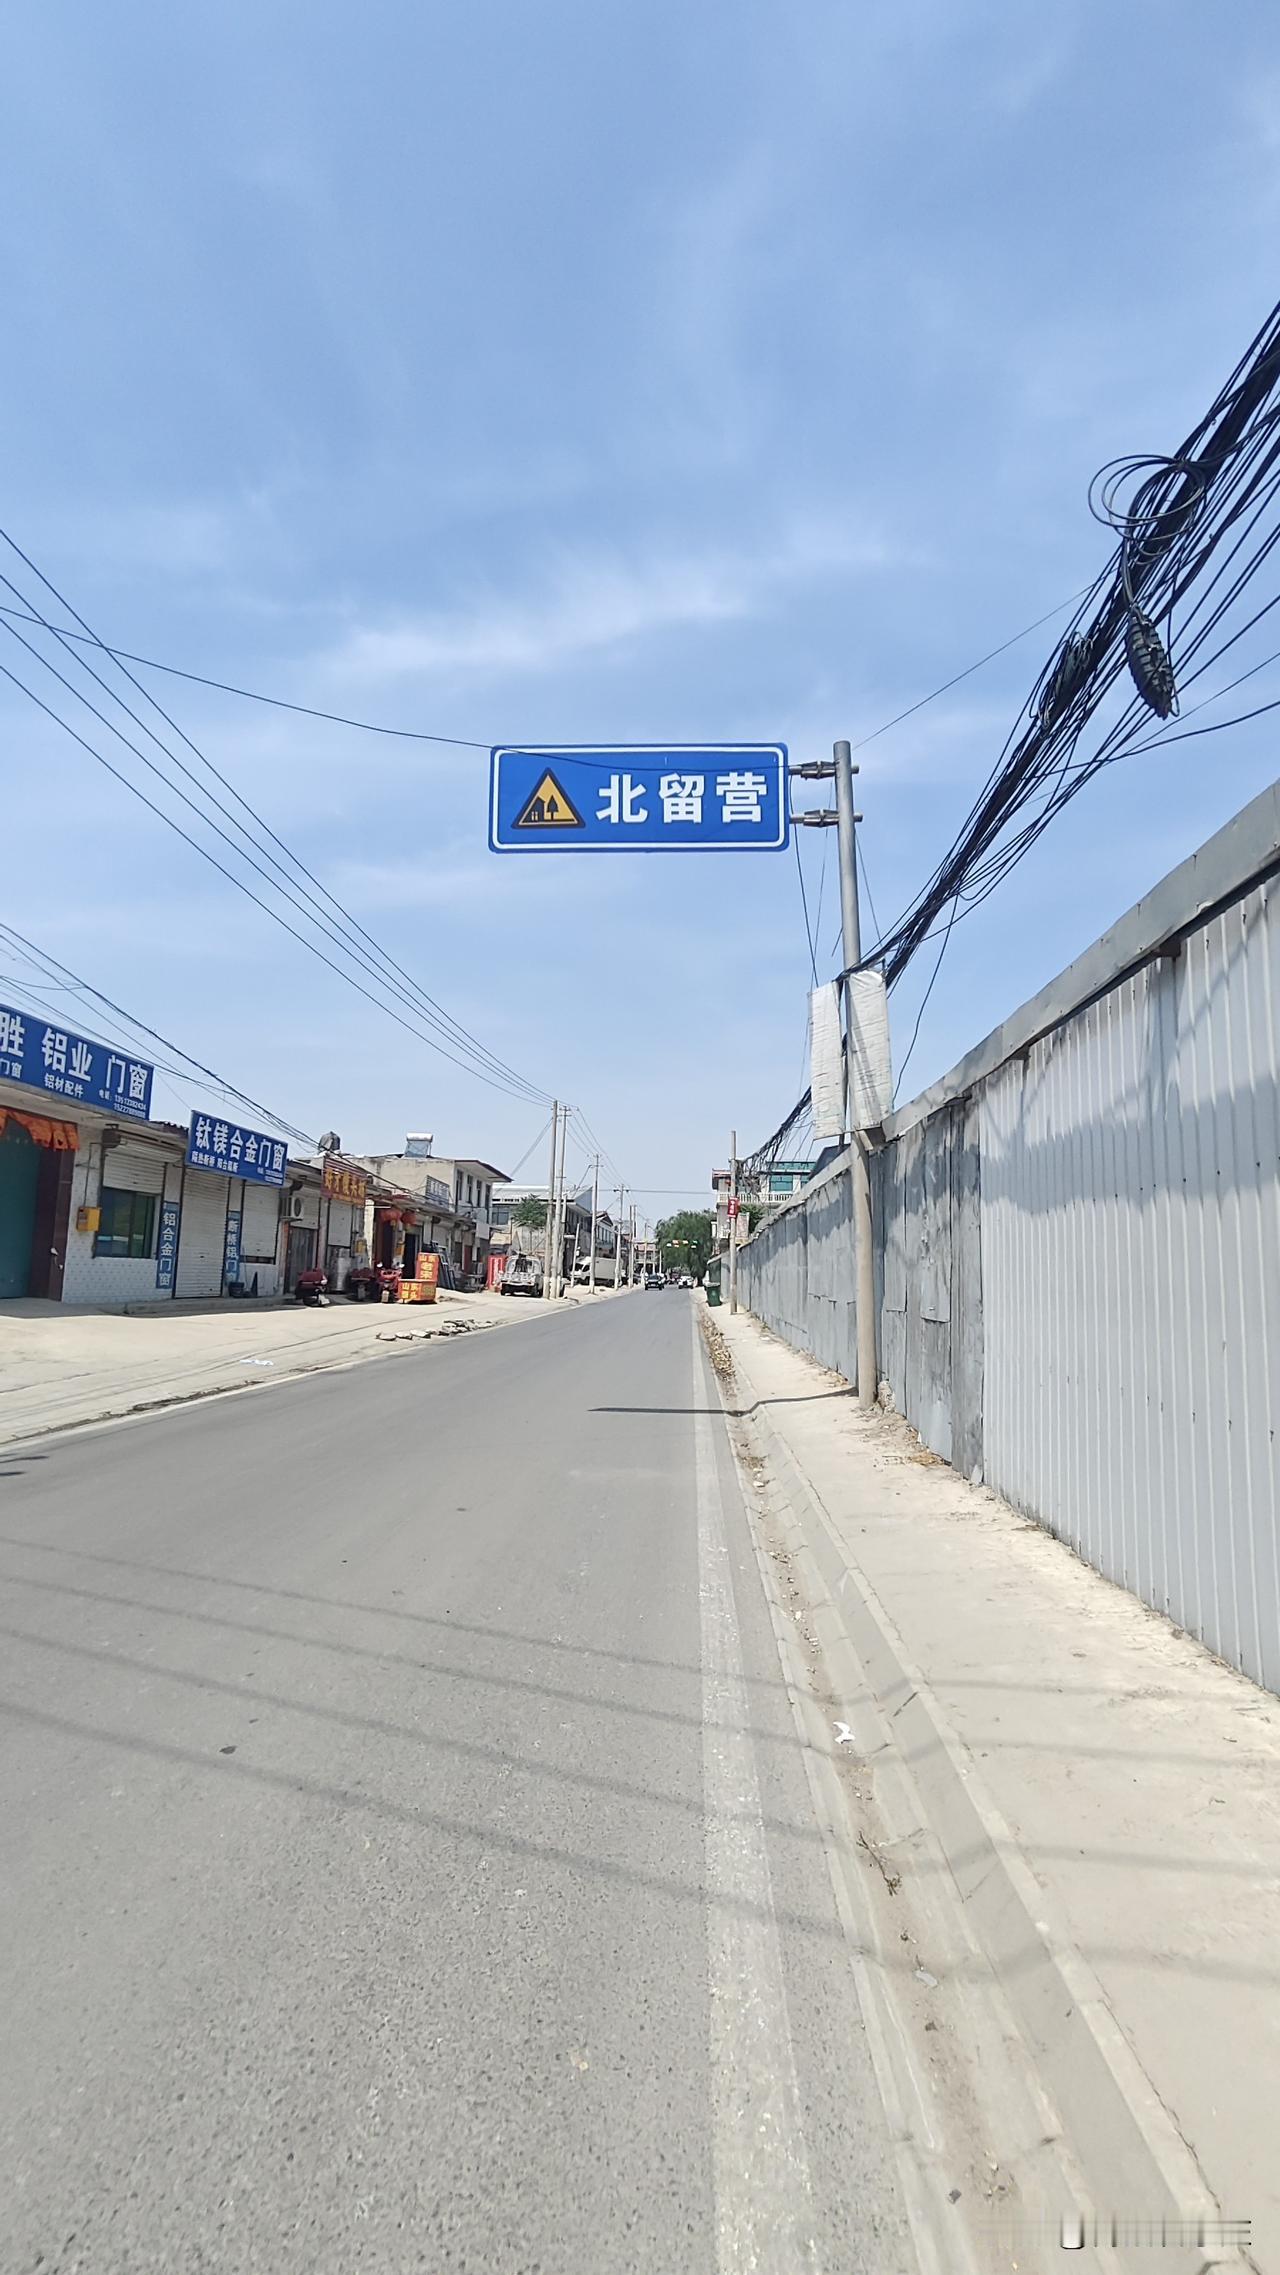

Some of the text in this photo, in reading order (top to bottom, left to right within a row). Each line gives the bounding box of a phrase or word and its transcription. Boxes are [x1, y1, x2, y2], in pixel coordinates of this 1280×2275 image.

[596, 772, 767, 824] 北留营
[42, 1027, 93, 1082] 铝业
[106, 1054, 148, 1101] 门窗
[44, 1072, 83, 1099] 铝材配件
[195, 1116, 285, 1171] 钛镁合金门窗
[159, 1212, 176, 1286] 铝合金门窗
